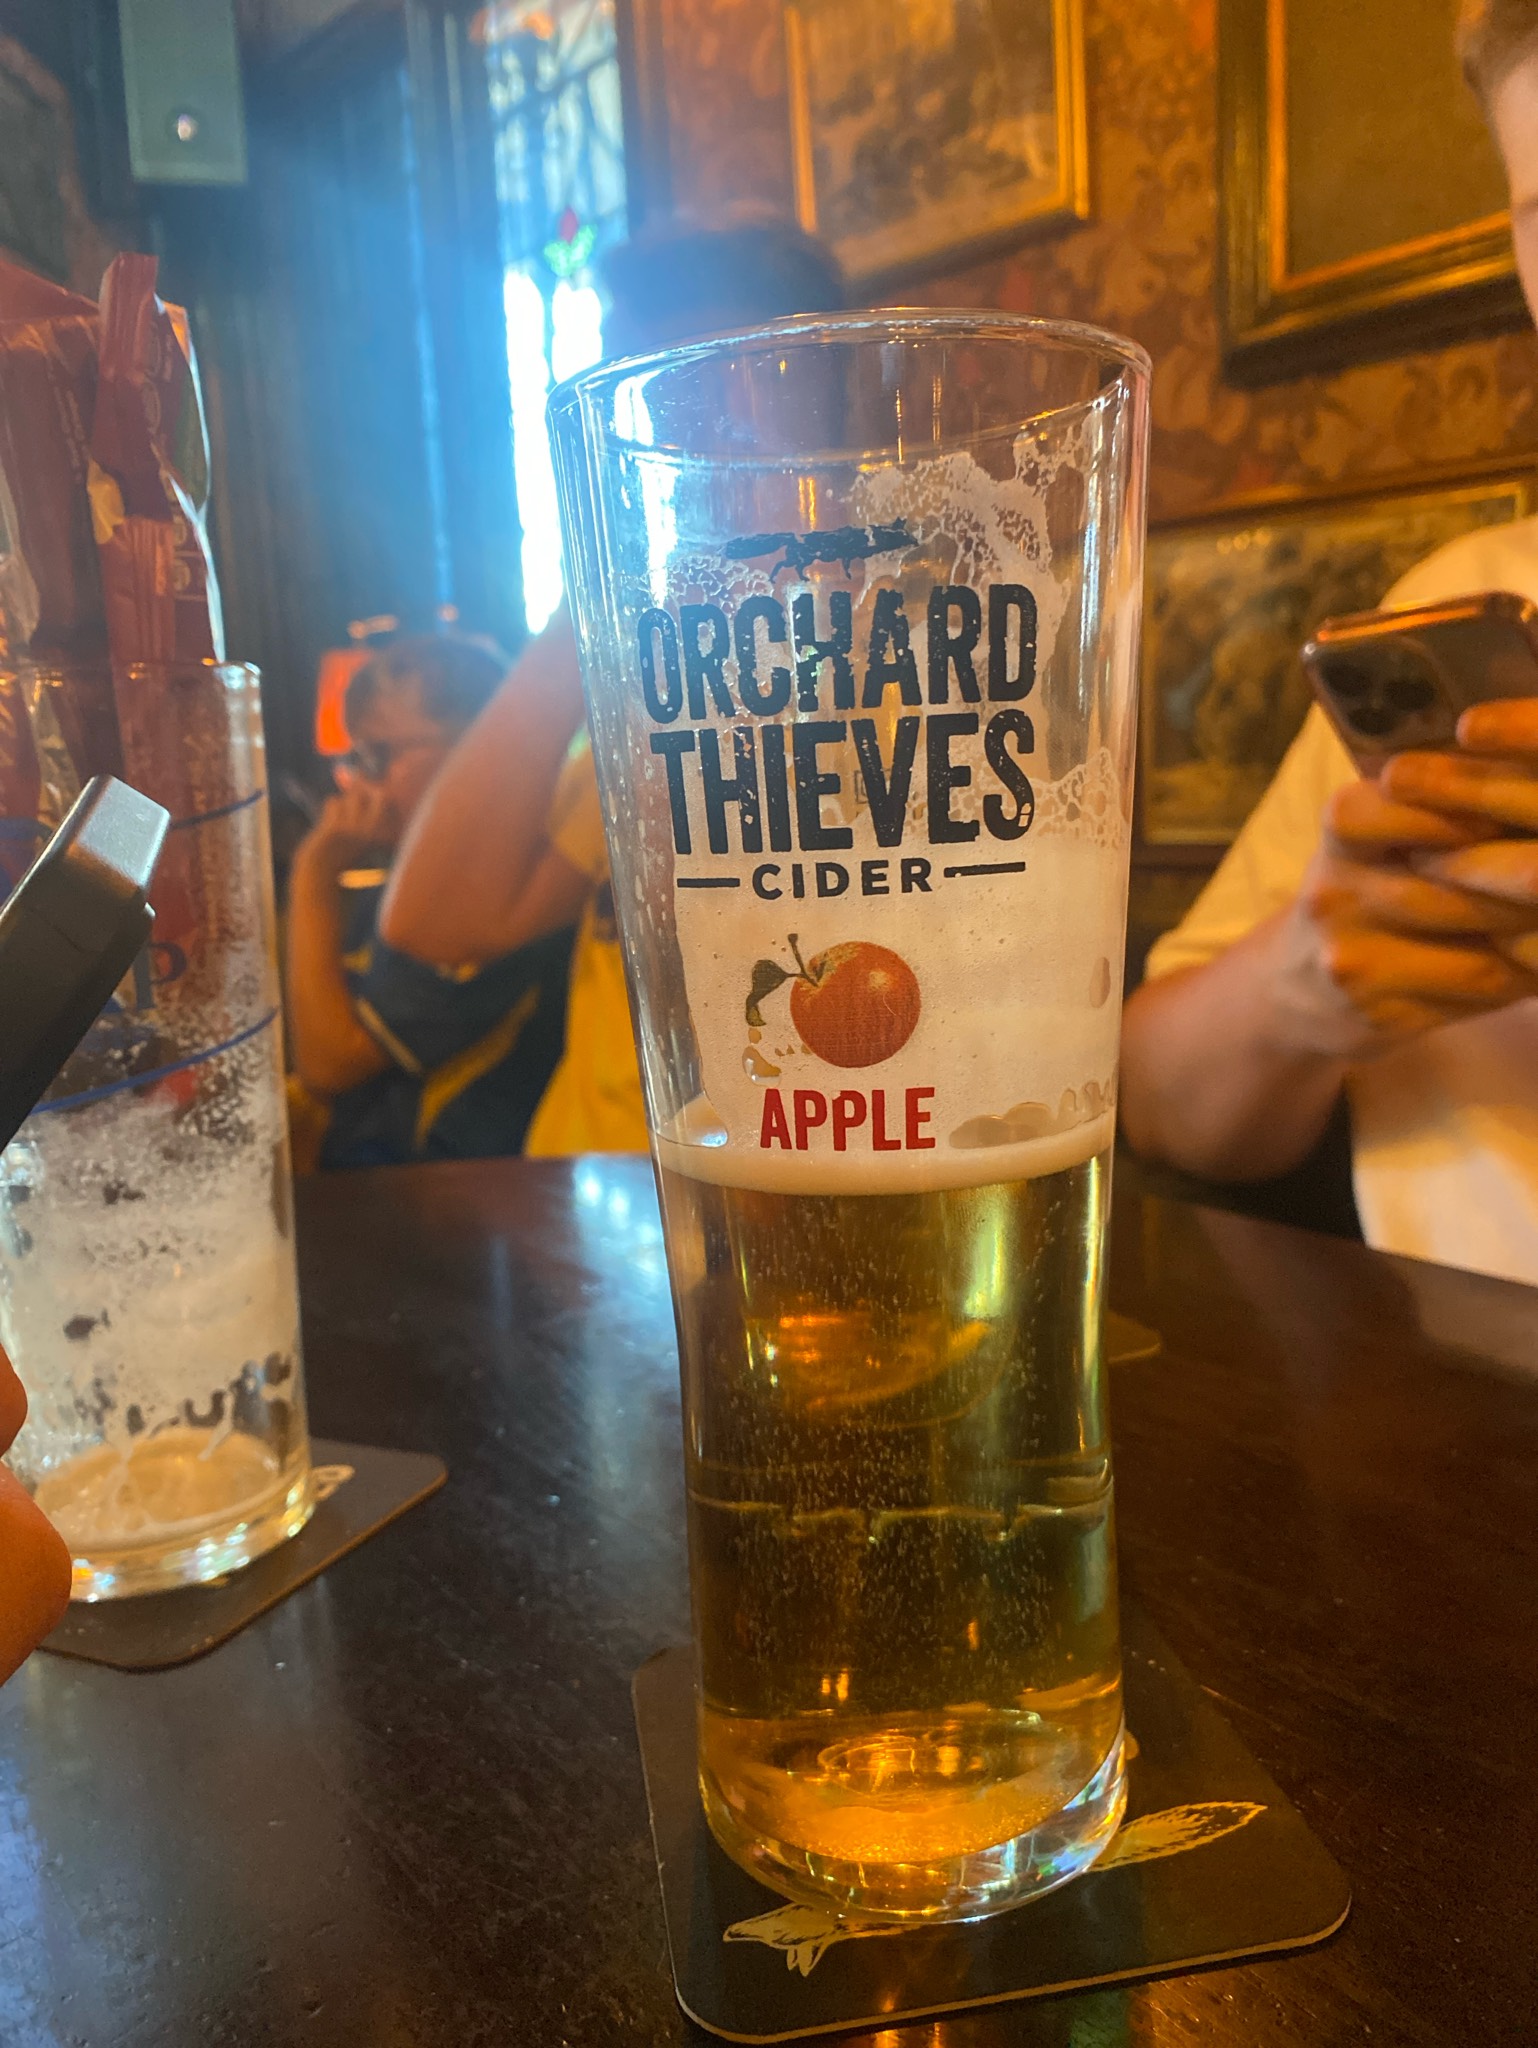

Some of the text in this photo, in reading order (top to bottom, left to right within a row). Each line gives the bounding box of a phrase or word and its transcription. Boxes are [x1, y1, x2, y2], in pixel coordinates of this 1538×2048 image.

[638, 584, 1038, 723] ORCHARD
[650, 709, 1035, 854] THIEVES
[752, 858, 933, 900] CIDER
[760, 1087, 936, 1151] APPLE
